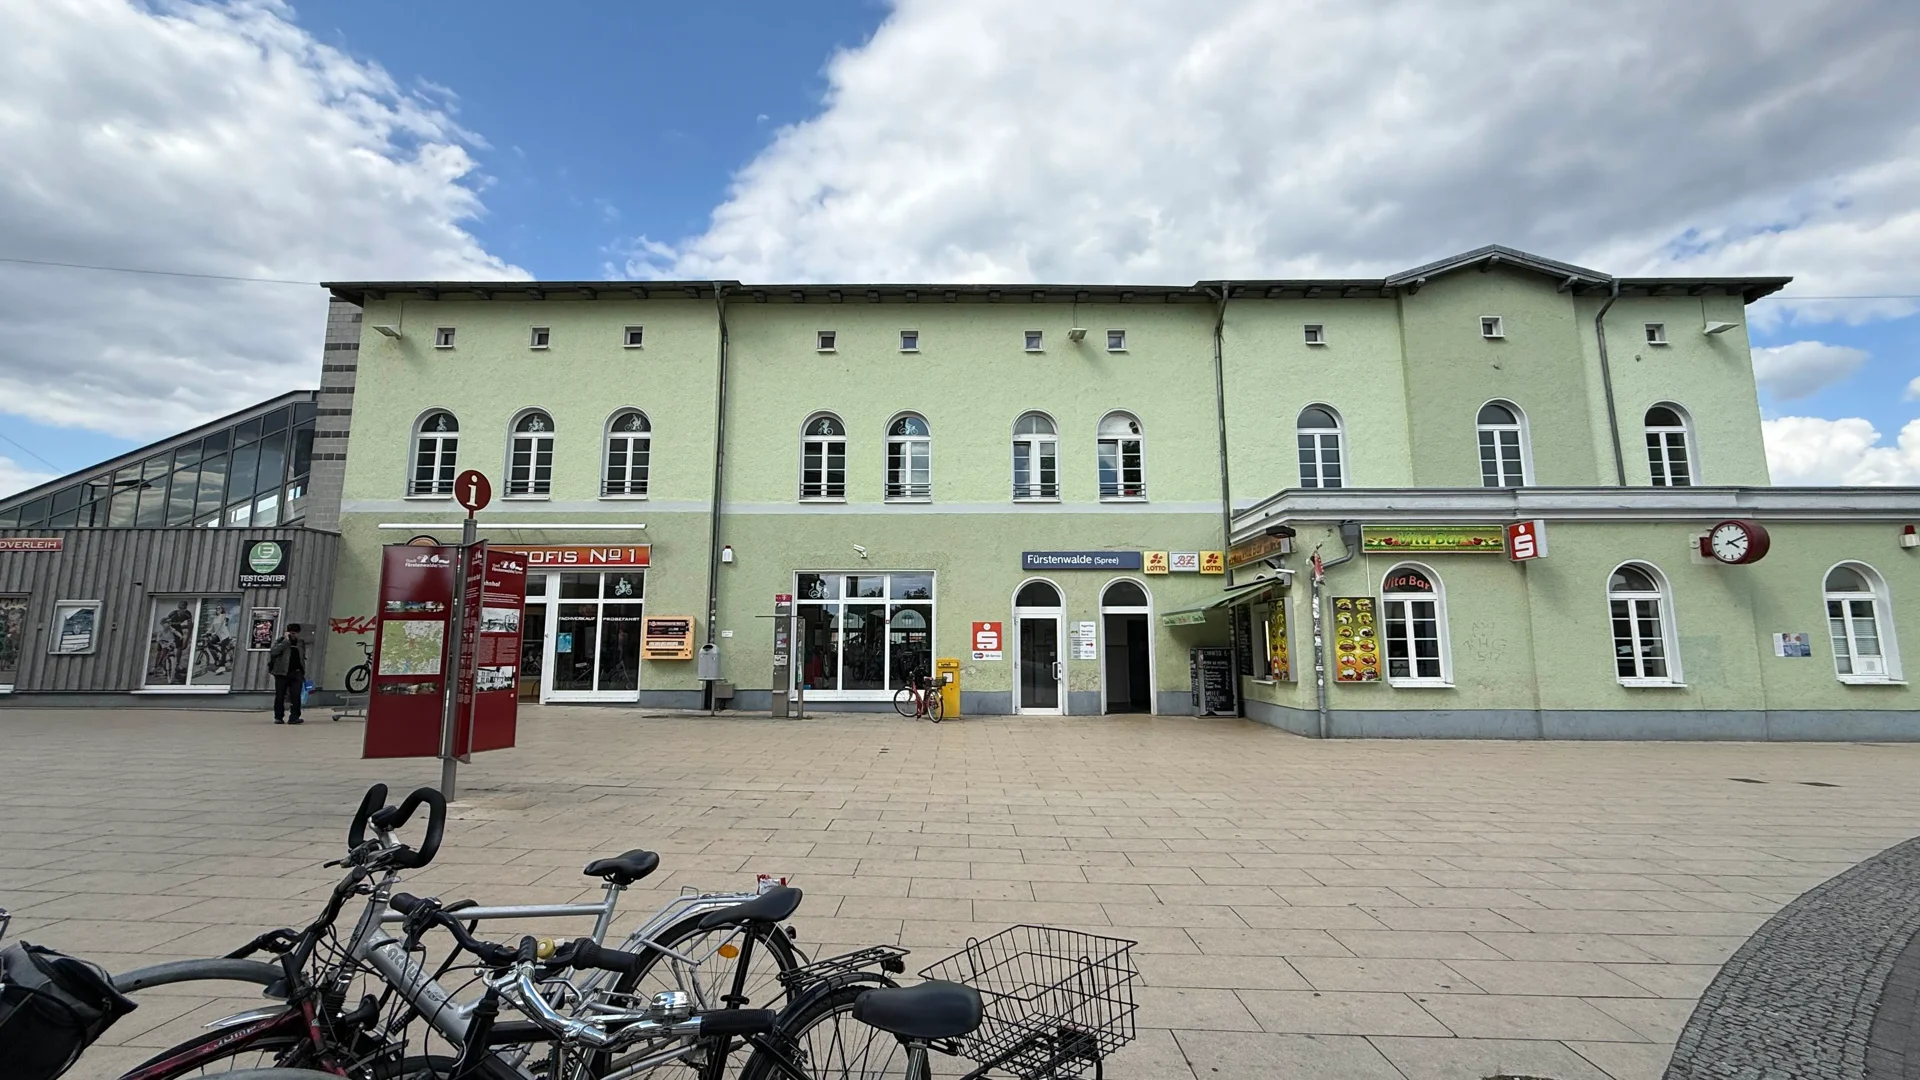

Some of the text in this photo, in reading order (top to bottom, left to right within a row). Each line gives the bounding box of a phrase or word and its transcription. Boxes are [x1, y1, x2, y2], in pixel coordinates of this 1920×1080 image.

[1399, 532, 1466, 546] Vita Bar
[1027, 554, 1119, 565] Fürstenwalde (Spree)
[240, 574, 286, 582] TESTCENTER
[1384, 575, 1431, 591] Vita Bar
